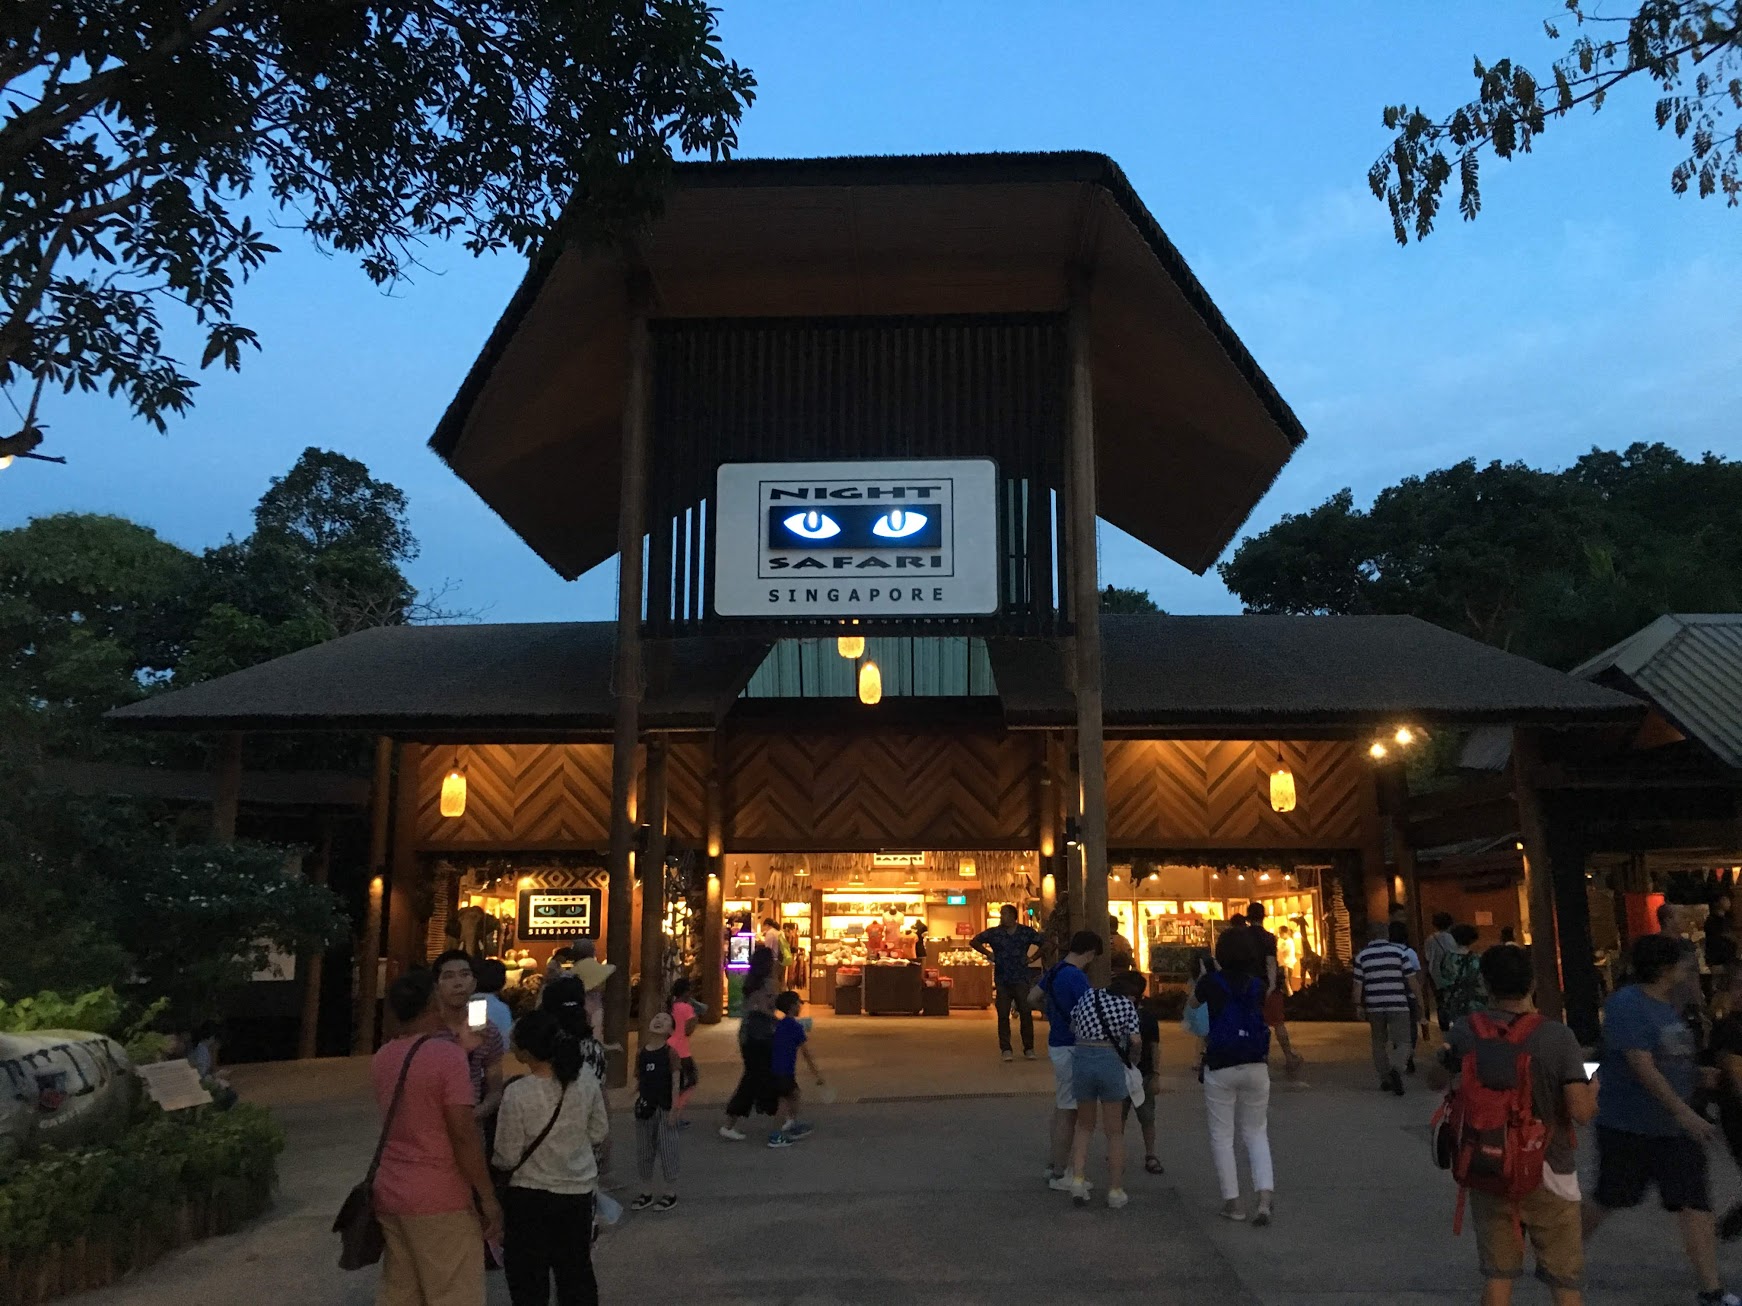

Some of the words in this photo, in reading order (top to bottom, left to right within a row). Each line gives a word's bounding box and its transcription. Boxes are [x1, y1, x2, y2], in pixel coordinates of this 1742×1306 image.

[770, 486, 942, 500] NIGHT
[769, 555, 942, 569] SAFARI
[768, 588, 943, 602] SINGAPORE
